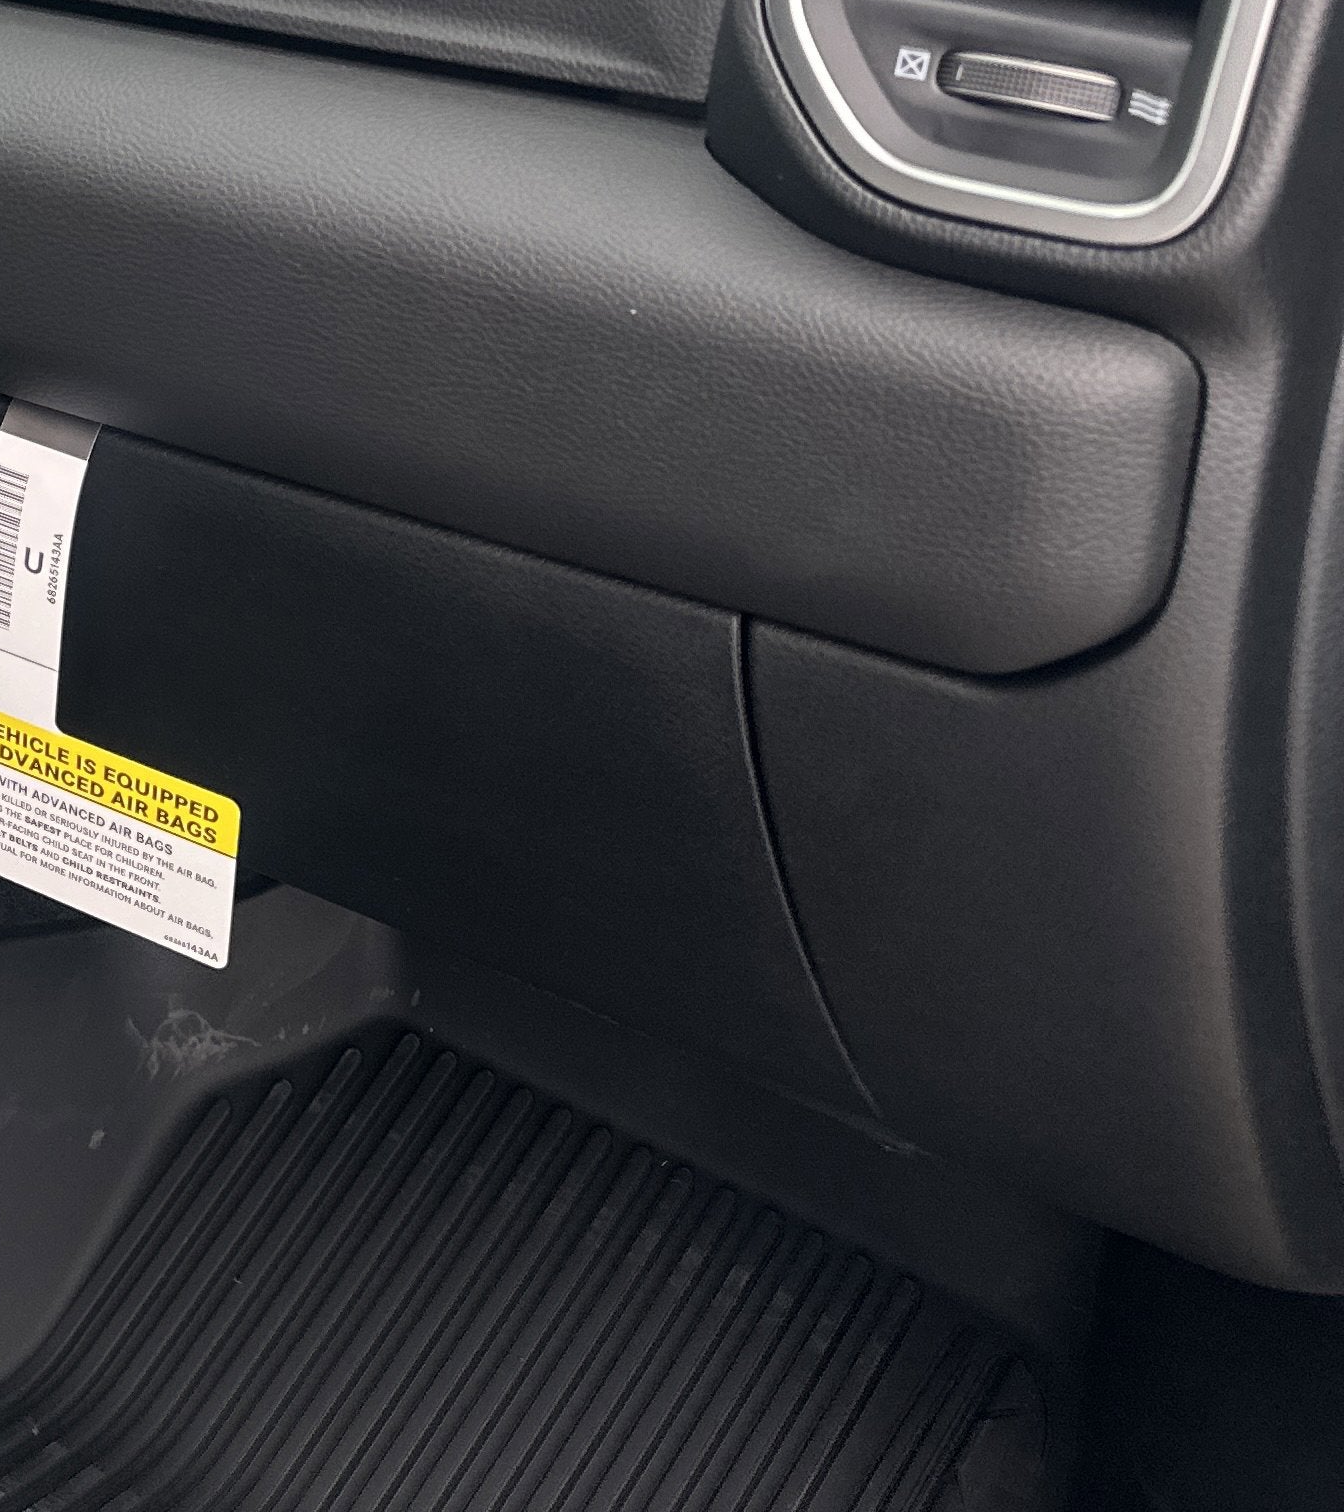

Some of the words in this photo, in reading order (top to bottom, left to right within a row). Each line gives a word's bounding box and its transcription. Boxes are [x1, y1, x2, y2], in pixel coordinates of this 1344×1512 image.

[24, 546, 44, 574] U
[46, 534, 64, 605] 68265143AA
[76, 753, 95, 776] IS
[104, 764, 218, 825] EQUIPPED
[111, 788, 147, 817] AIR
[156, 806, 217, 845] BAGS
[1, 792, 32, 813] KILLED
[34, 806, 47, 819] OR
[49, 812, 98, 840] SERIOUSLY
[101, 833, 139, 857] INJURED
[142, 850, 154, 863] BY
[156, 856, 174, 871] THE
[177, 864, 192, 879] AIR
[5, 806, 22, 821] THE
[24, 814, 61, 837] SAFEST
[64, 830, 92, 850] PLACE
[95, 843, 113, 858] FOR
[32, 788, 105, 828] ADVANCED
[109, 819, 131, 839] AIR
[136, 830, 172, 856] BAGS
[9, 833, 38, 852] BELTS
[40, 846, 59, 861] AND
[62, 855, 92, 875] CHILD
